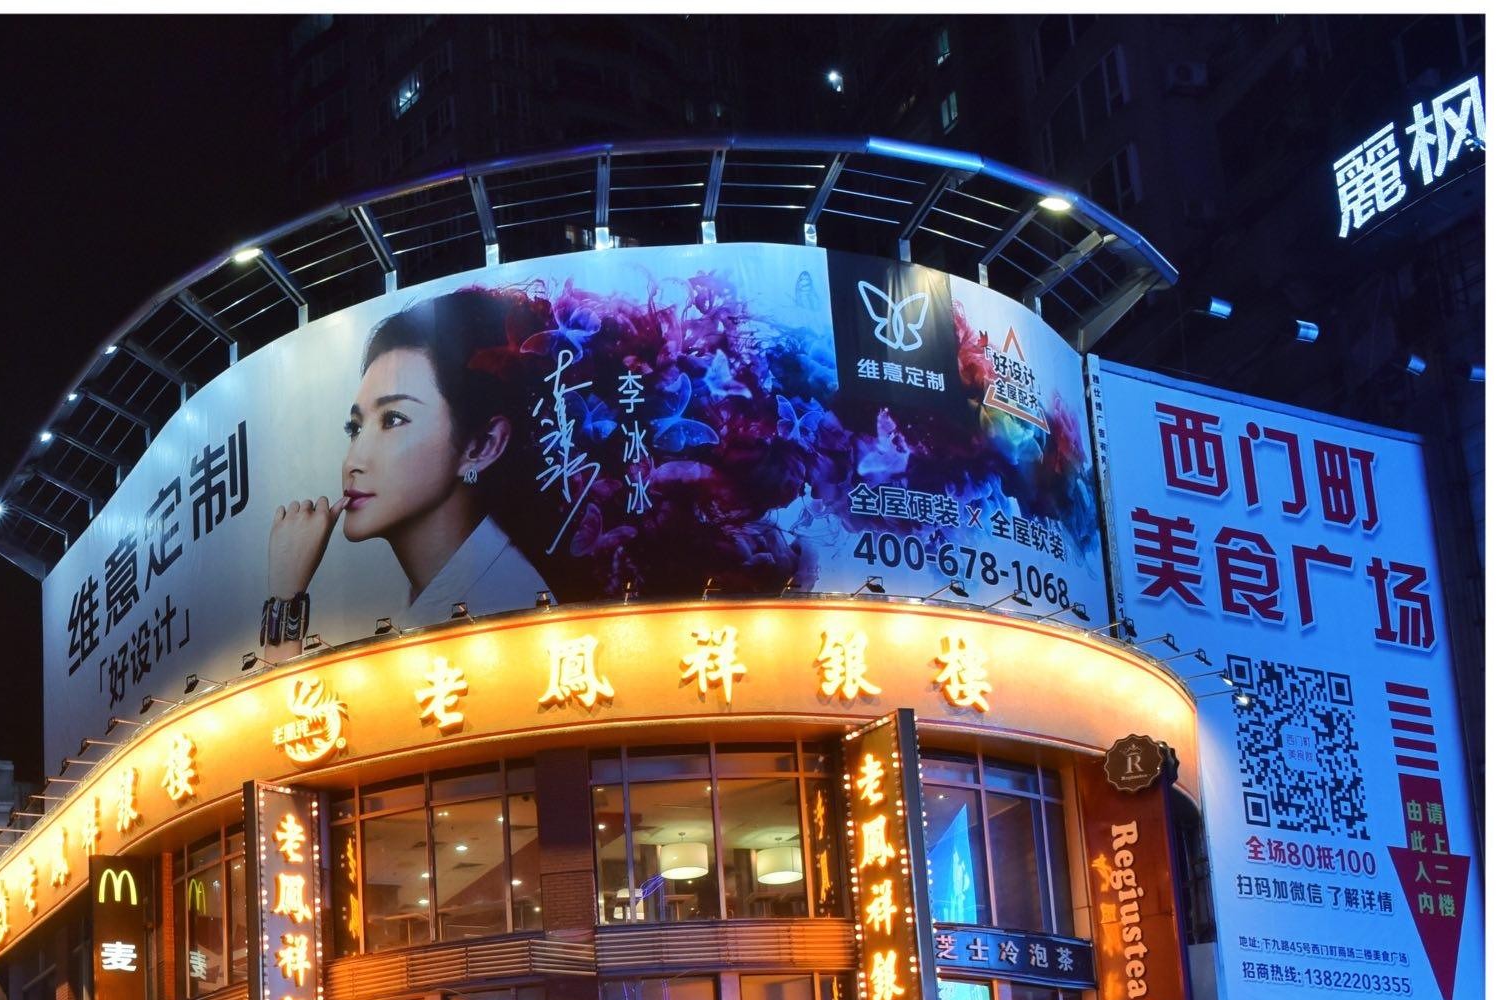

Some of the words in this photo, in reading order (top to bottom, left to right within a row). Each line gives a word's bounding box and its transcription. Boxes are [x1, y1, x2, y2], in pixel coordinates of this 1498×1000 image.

[857, 358, 945, 392] 维意定制
[617, 371, 653, 514] 李冰冰
[1155, 401, 1380, 532] 西门町
[68, 420, 250, 676] 维意定制
[849, 483, 960, 527] 全屋硬装
[990, 510, 1066, 561] 全屋软装
[853, 532, 1070, 609] 400-678-1068
[1131, 507, 1436, 649] 美食广场
[416, 625, 994, 731] 老鳳祥銀樓
[1236, 875, 1323, 904] 扫码加微信
[1328, 886, 1394, 914] 了解详情
[1245, 836, 1378, 877] 全场80抵100
[935, 934, 1074, 972] 芝士冷泡茶
[1111, 820, 1149, 999] Regiustea
